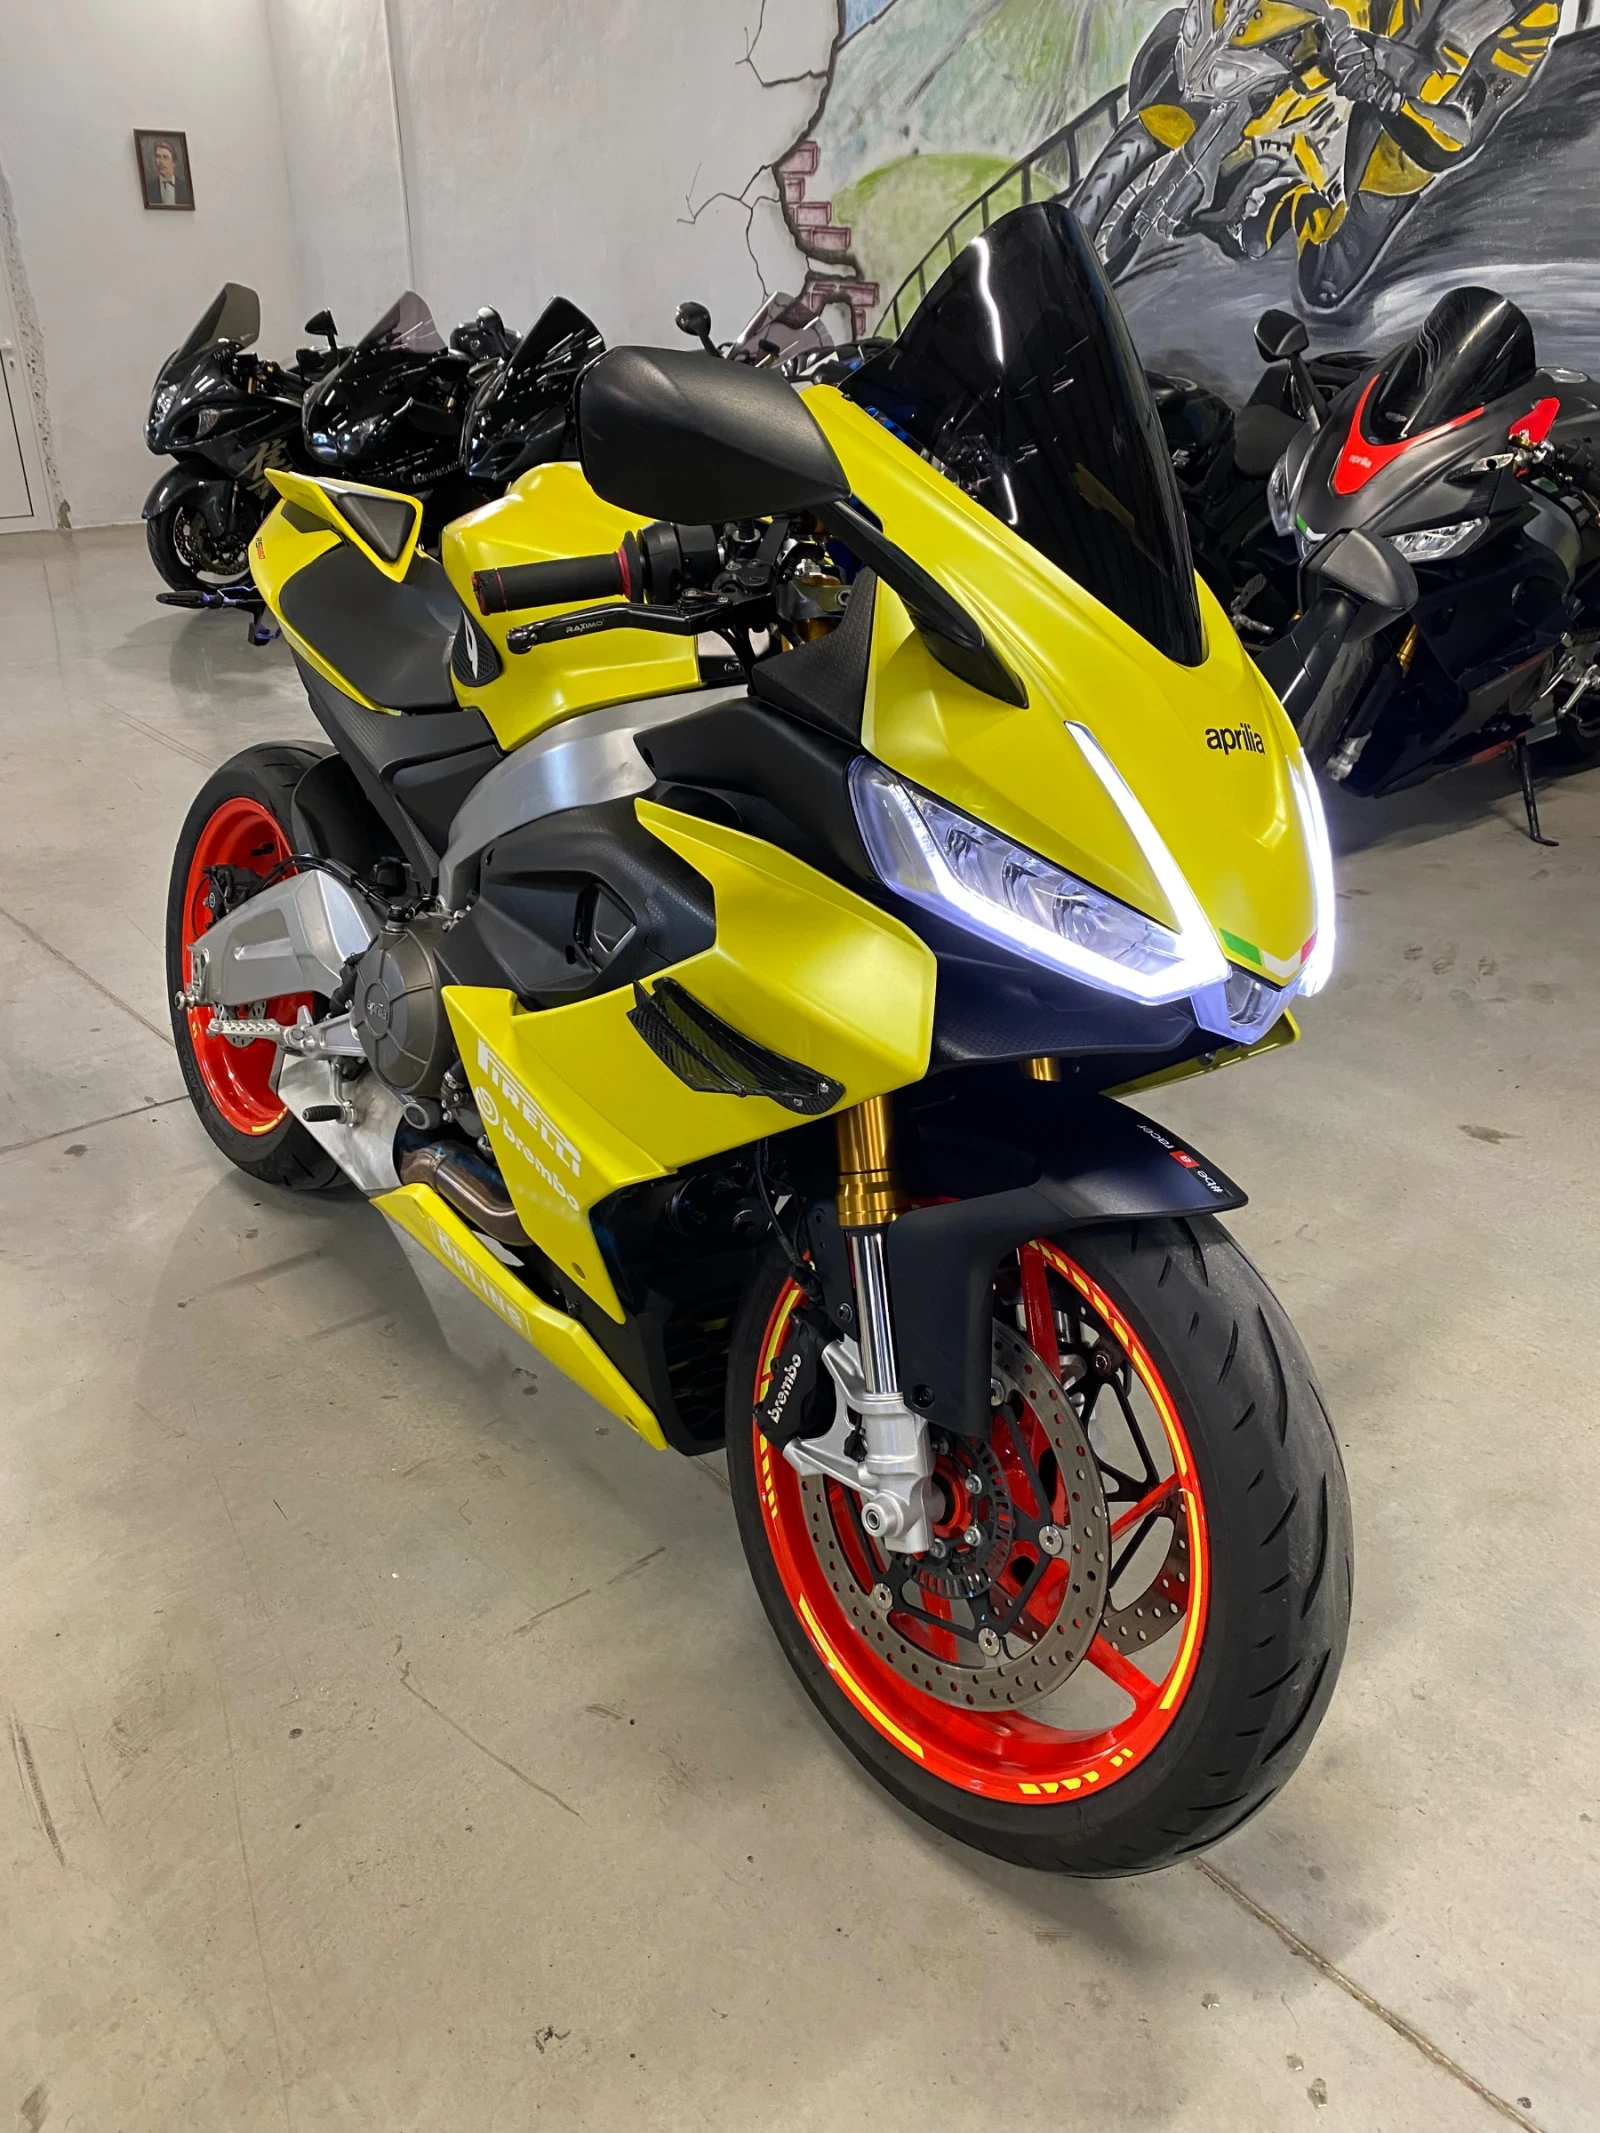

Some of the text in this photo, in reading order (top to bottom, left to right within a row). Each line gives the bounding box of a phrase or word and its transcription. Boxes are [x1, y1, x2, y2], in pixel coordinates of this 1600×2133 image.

[1348, 454, 1372, 468] aprilia
[566, 620, 603, 633] RAXIMO
[1205, 722, 1265, 755] aprilia
[477, 1038, 581, 1177] PIRELLI
[1137, 1124, 1174, 1149] racer
[503, 1118, 579, 1211] brembo
[767, 1354, 802, 1423] brembo
